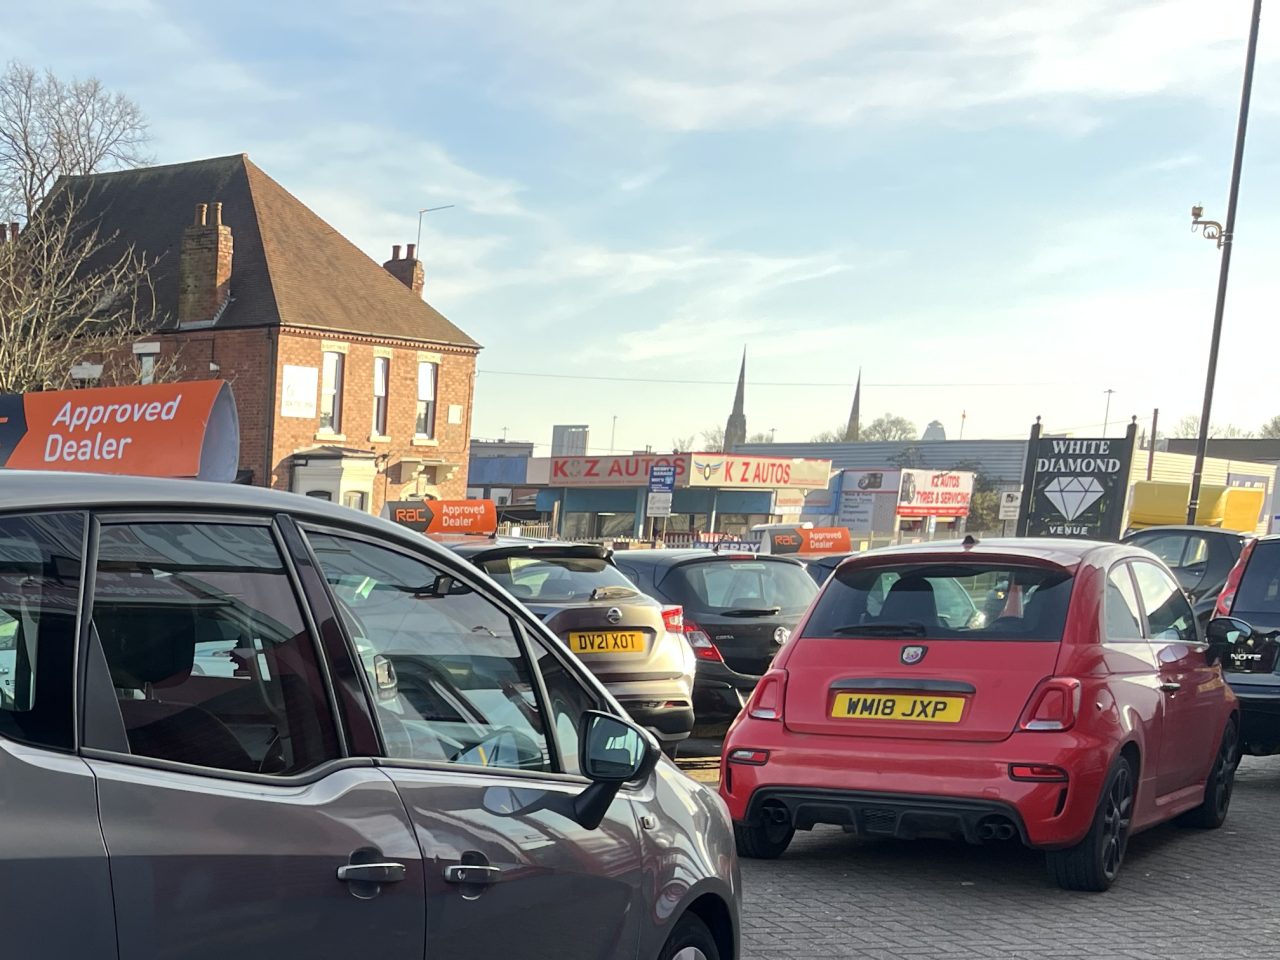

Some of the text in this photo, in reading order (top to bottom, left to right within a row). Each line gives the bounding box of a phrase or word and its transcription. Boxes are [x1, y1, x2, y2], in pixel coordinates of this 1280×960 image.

[52, 394, 182, 432] Approved
[44, 432, 132, 462] Dealer
[1052, 440, 1110, 454] WHITE
[1037, 459, 1120, 472] DIAMOND
[753, 463, 791, 484] AUTOS
[931, 475, 960, 488] KZ AUTOS
[916, 491, 934, 504] TYRES
[940, 492, 970, 505] SERVICING
[396, 509, 426, 522] RAC
[442, 504, 485, 515] Approved
[442, 516, 473, 526] Dealer
[809, 531, 842, 540] Approved
[1049, 526, 1088, 535] VENUE
[774, 535, 797, 546] RAC
[810, 540, 833, 549] Dealer
[578, 634, 636, 650] DV21 XOT
[847, 698, 948, 718] WM18 JXP
